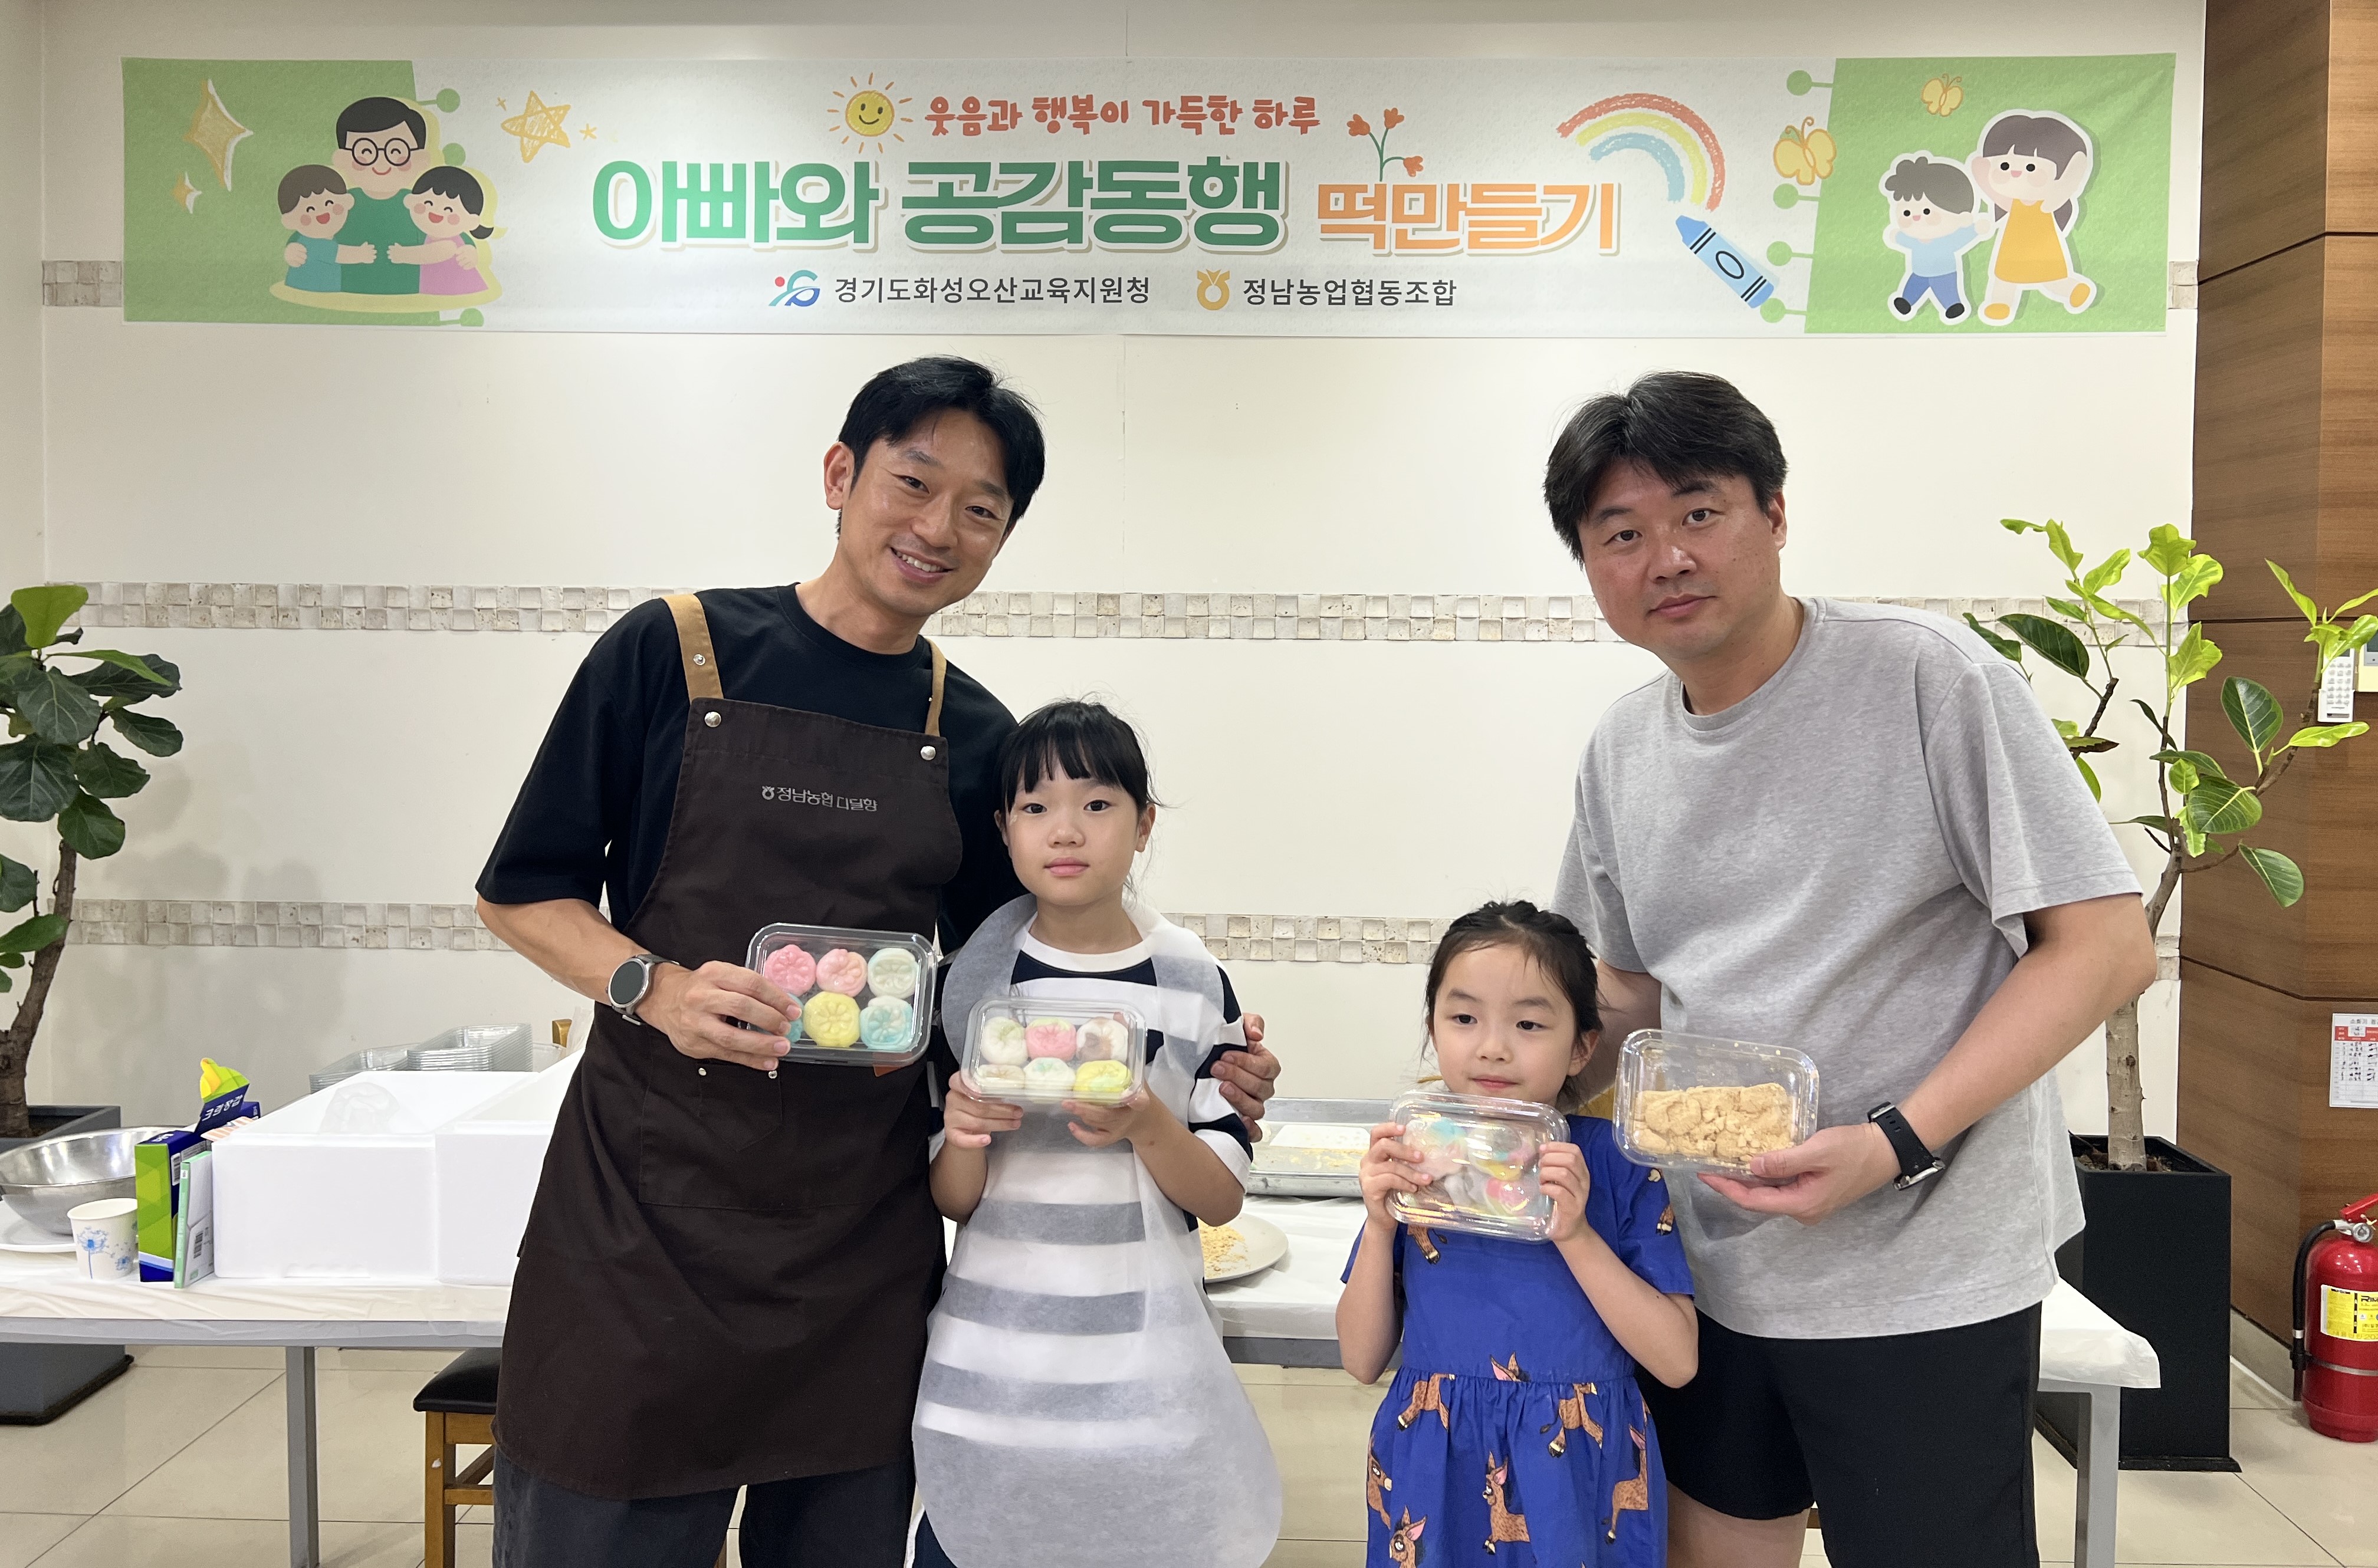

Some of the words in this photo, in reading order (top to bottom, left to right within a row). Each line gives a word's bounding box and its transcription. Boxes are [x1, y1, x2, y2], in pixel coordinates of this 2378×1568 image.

[925, 96, 1023, 136] 웃음과
[1032, 94, 1129, 135] 행복이
[1141, 95, 1243, 136] 가득한
[1252, 96, 1321, 136] 하루
[593, 160, 879, 244] 아빠와
[902, 156, 1281, 246] 공감동행
[1318, 183, 1614, 250] 떡만들기
[835, 276, 1149, 304] 경기도화성오산교육지원청
[1243, 278, 1457, 307] 정남농업협동조합
[777, 787, 833, 807] 정남농협
